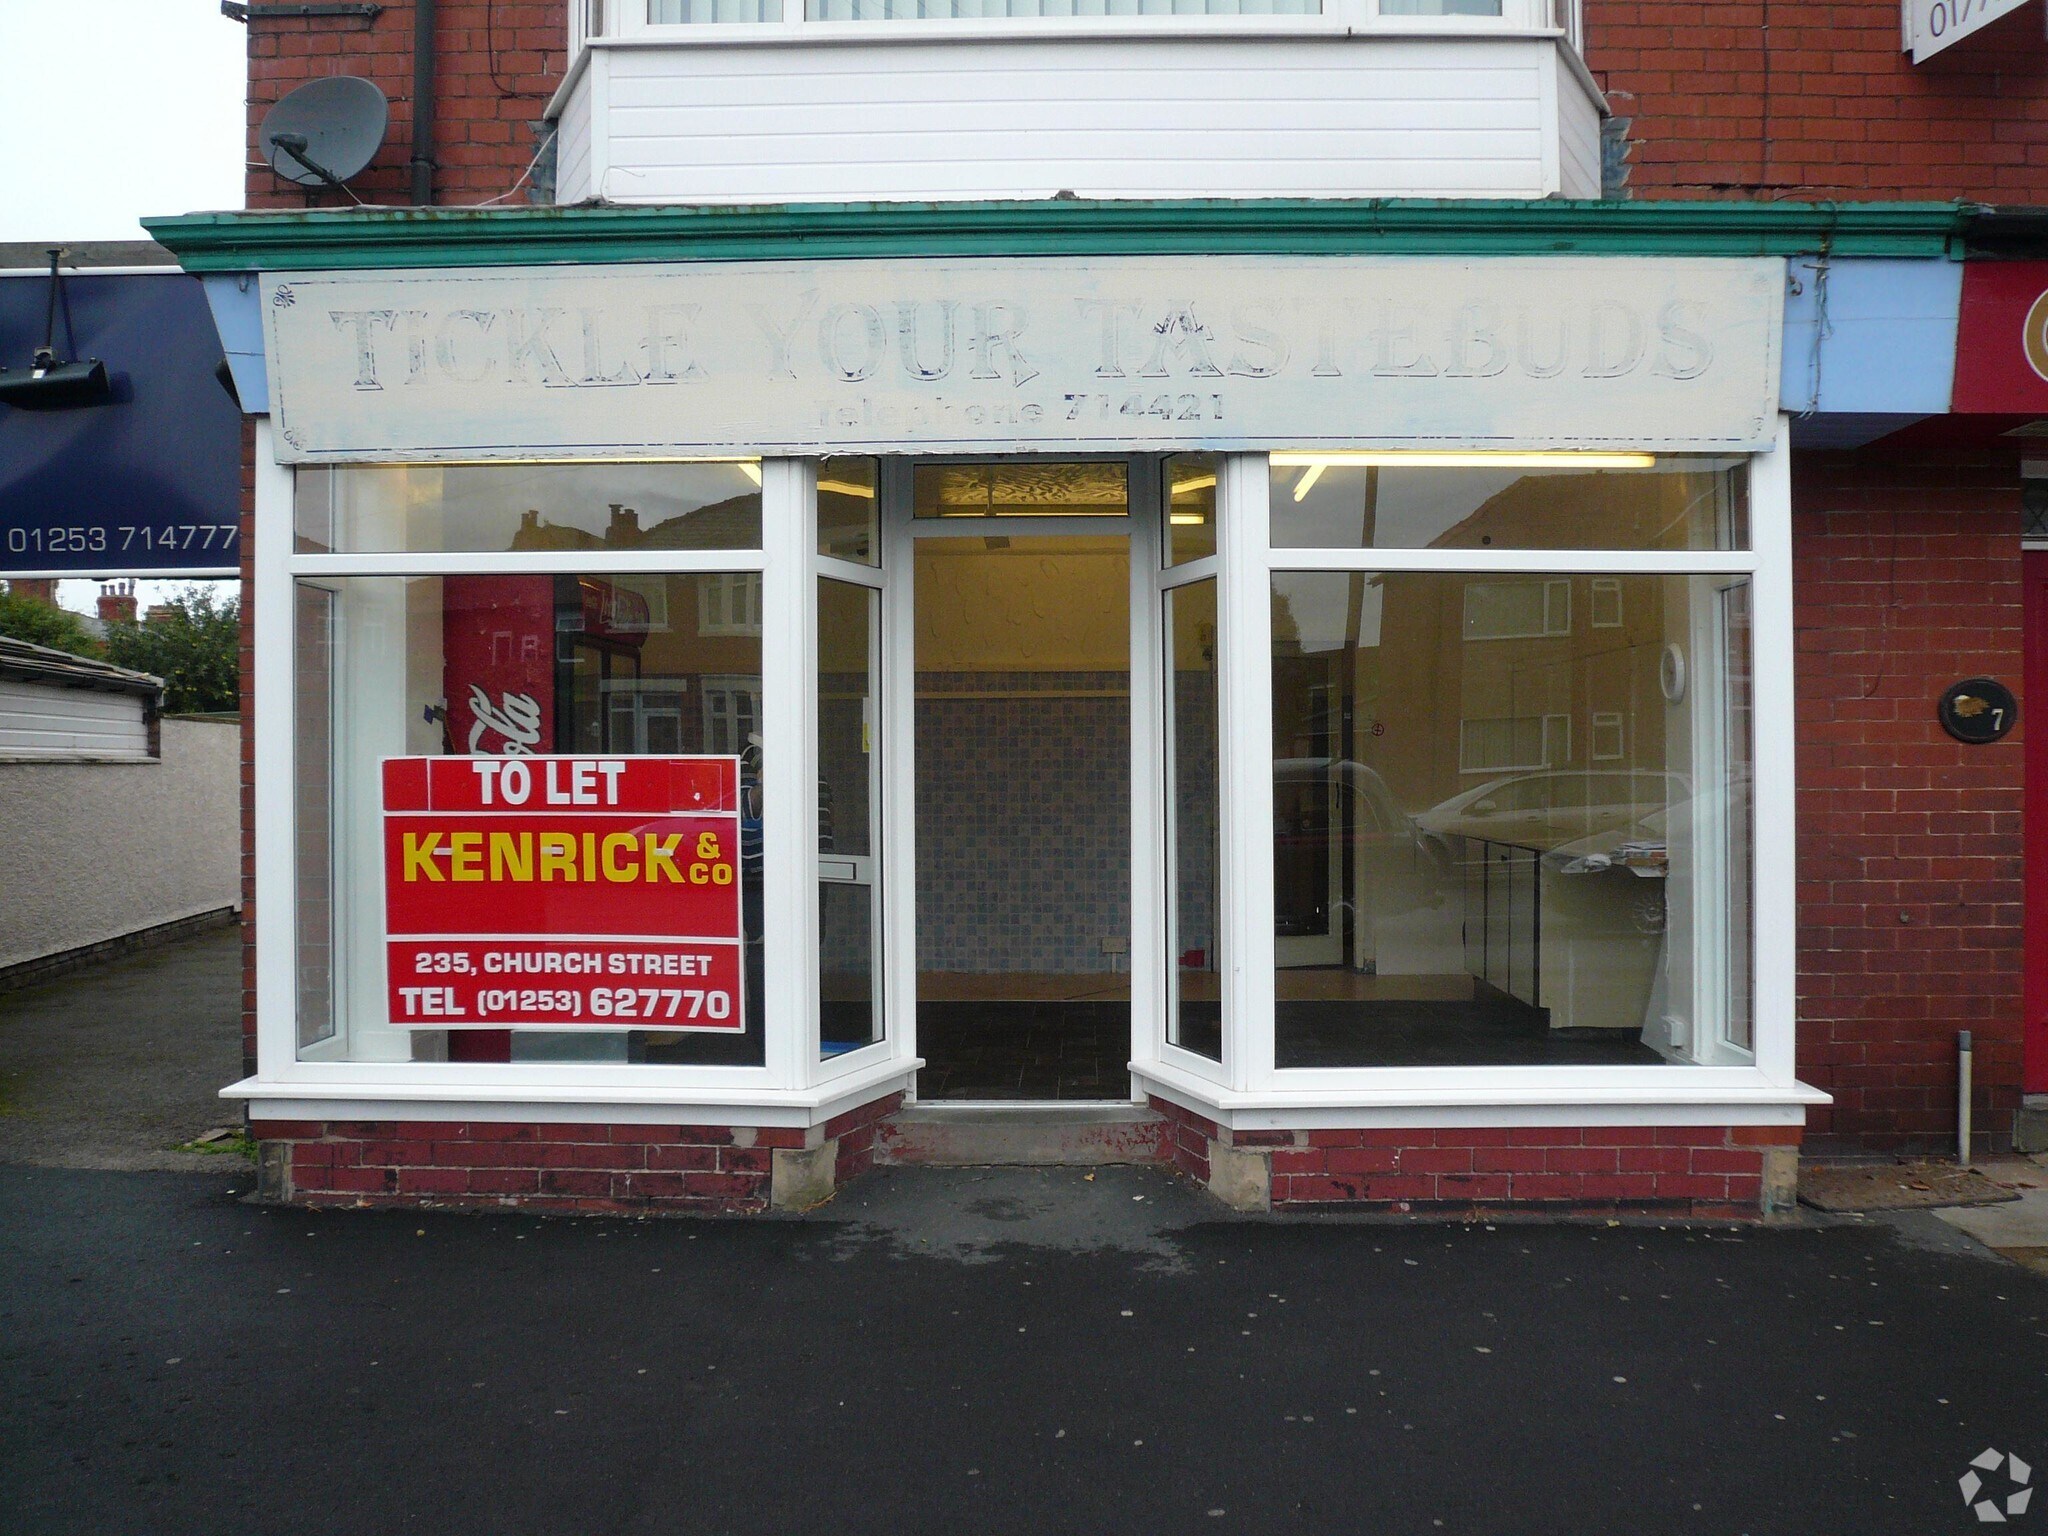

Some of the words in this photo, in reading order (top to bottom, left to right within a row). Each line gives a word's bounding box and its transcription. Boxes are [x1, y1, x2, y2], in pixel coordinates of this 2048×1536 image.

[328, 302, 711, 391] TICKLE
[742, 288, 1040, 388] YOUR
[1062, 392, 1225, 422] 714421
[7, 526, 107, 552] 01253
[118, 524, 239, 550] 714777
[1991, 708, 2004, 731] 7
[472, 760, 532, 805] TO
[546, 760, 626, 805] LET
[402, 831, 686, 884] KENRICK
[696, 831, 721, 859] &
[689, 862, 733, 886] CO
[415, 951, 478, 977] 235,
[483, 952, 602, 974] CHURCH
[608, 953, 713, 976] STREET
[399, 986, 466, 1016] TEL
[477, 989, 582, 1017] (01253)
[589, 987, 731, 1020] 627770
